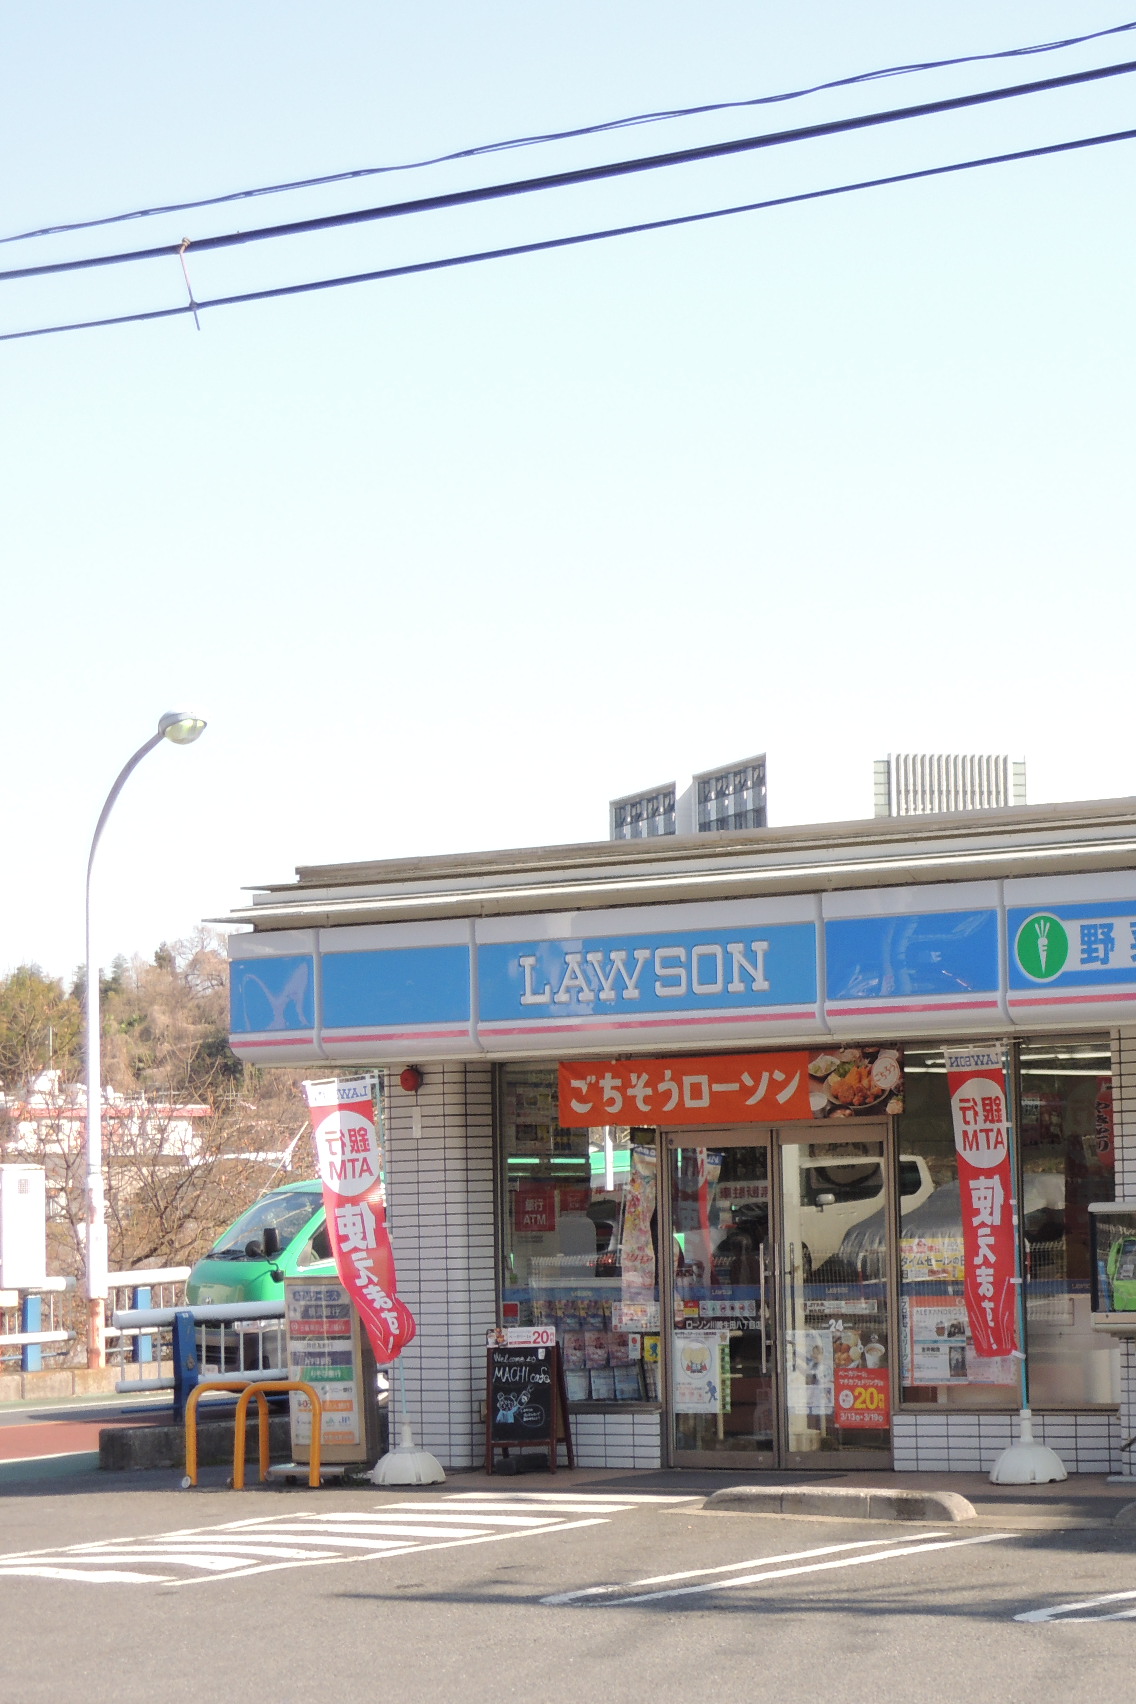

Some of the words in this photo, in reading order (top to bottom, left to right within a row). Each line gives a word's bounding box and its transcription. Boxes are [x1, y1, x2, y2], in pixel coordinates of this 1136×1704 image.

[518, 940, 770, 1006] LAWSON
[570, 1068, 801, 1114] ごちそうローソン
[523, 1214, 546, 1225] ATM
[828, 1318, 844, 1331] 24
[493, 1352, 525, 1363] Welcome
[493, 1366, 529, 1383] MACHI
